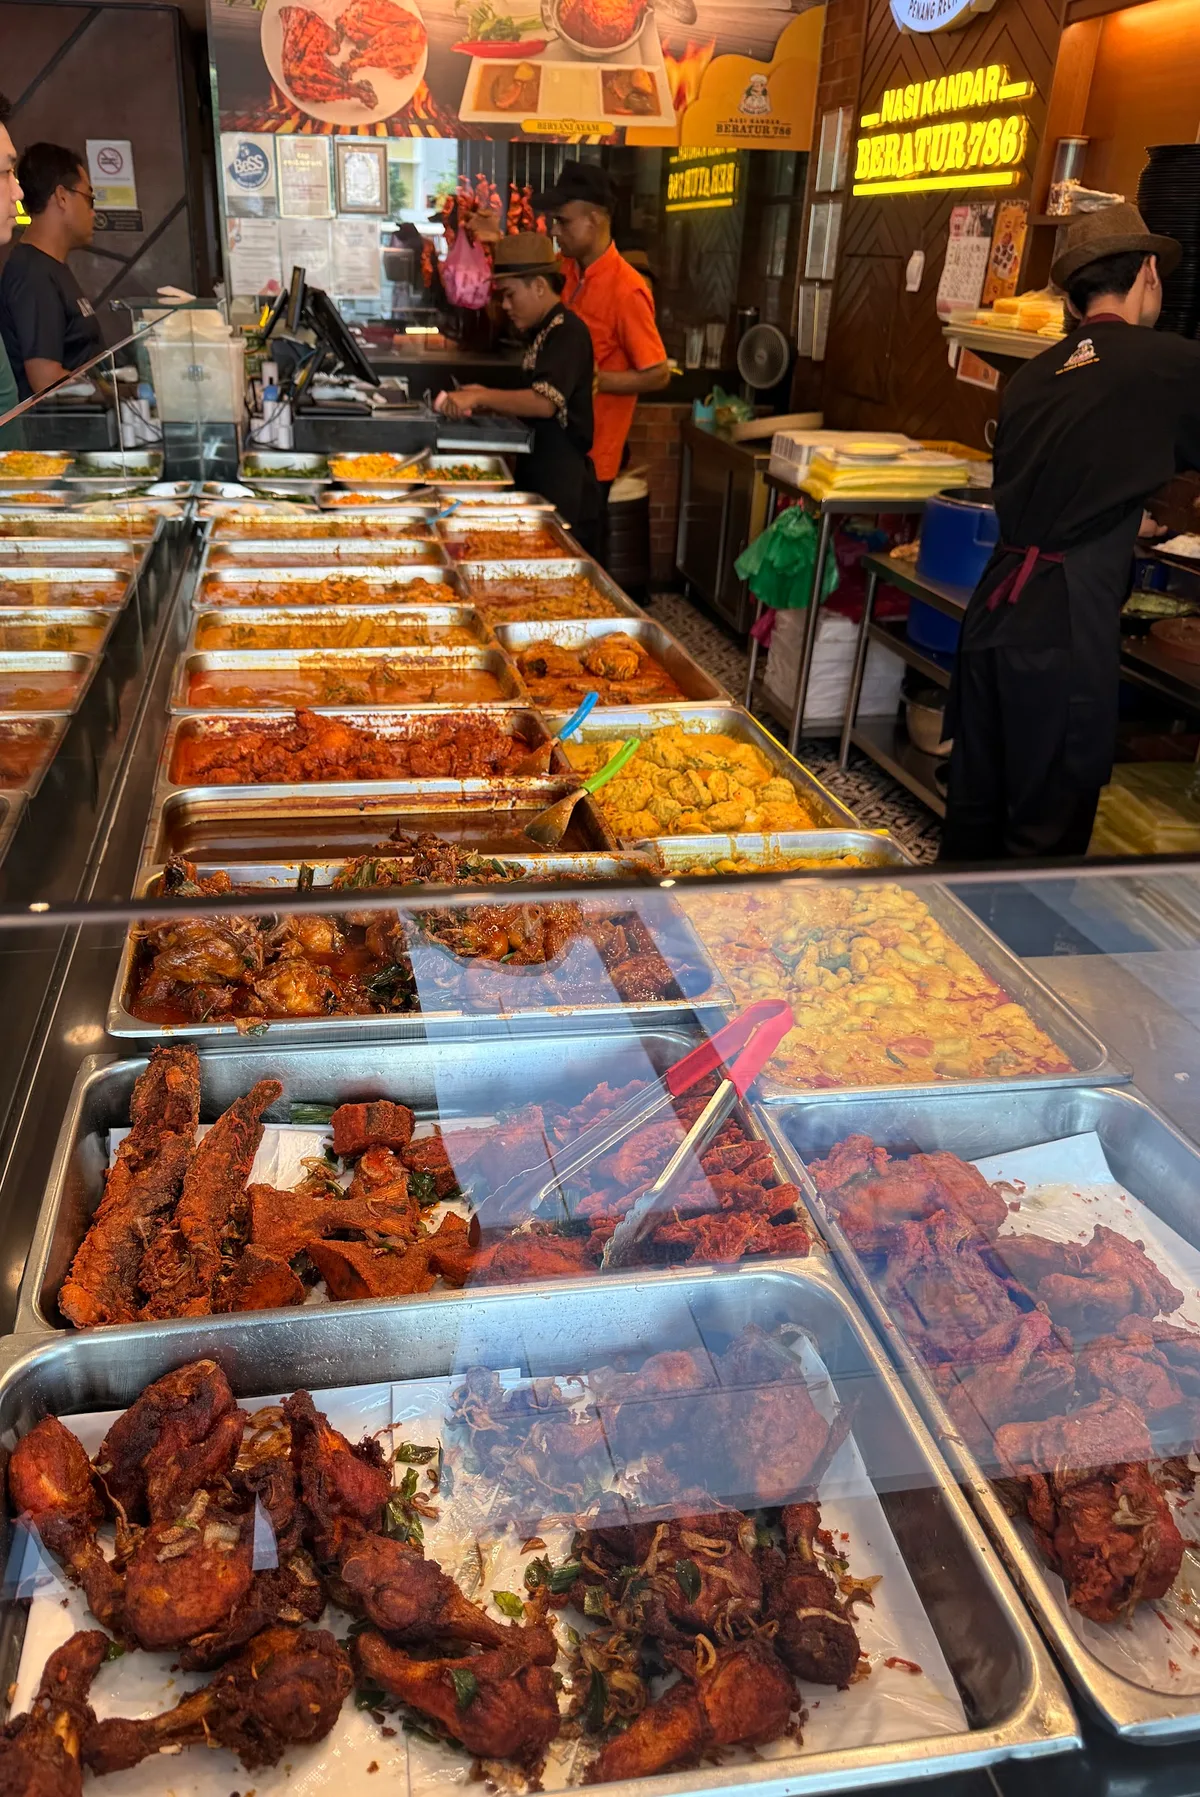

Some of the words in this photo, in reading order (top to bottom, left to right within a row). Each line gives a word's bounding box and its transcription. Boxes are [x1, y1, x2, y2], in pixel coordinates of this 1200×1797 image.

[908, 0, 935, 20] PENANG
[881, 83, 920, 122] NASI
[919, 65, 1003, 114] KANDAR
[716, 123, 770, 134] BERATUR
[773, 126, 792, 135] 786
[855, 121, 968, 179] BERATUR
[968, 116, 1021, 168] 786
